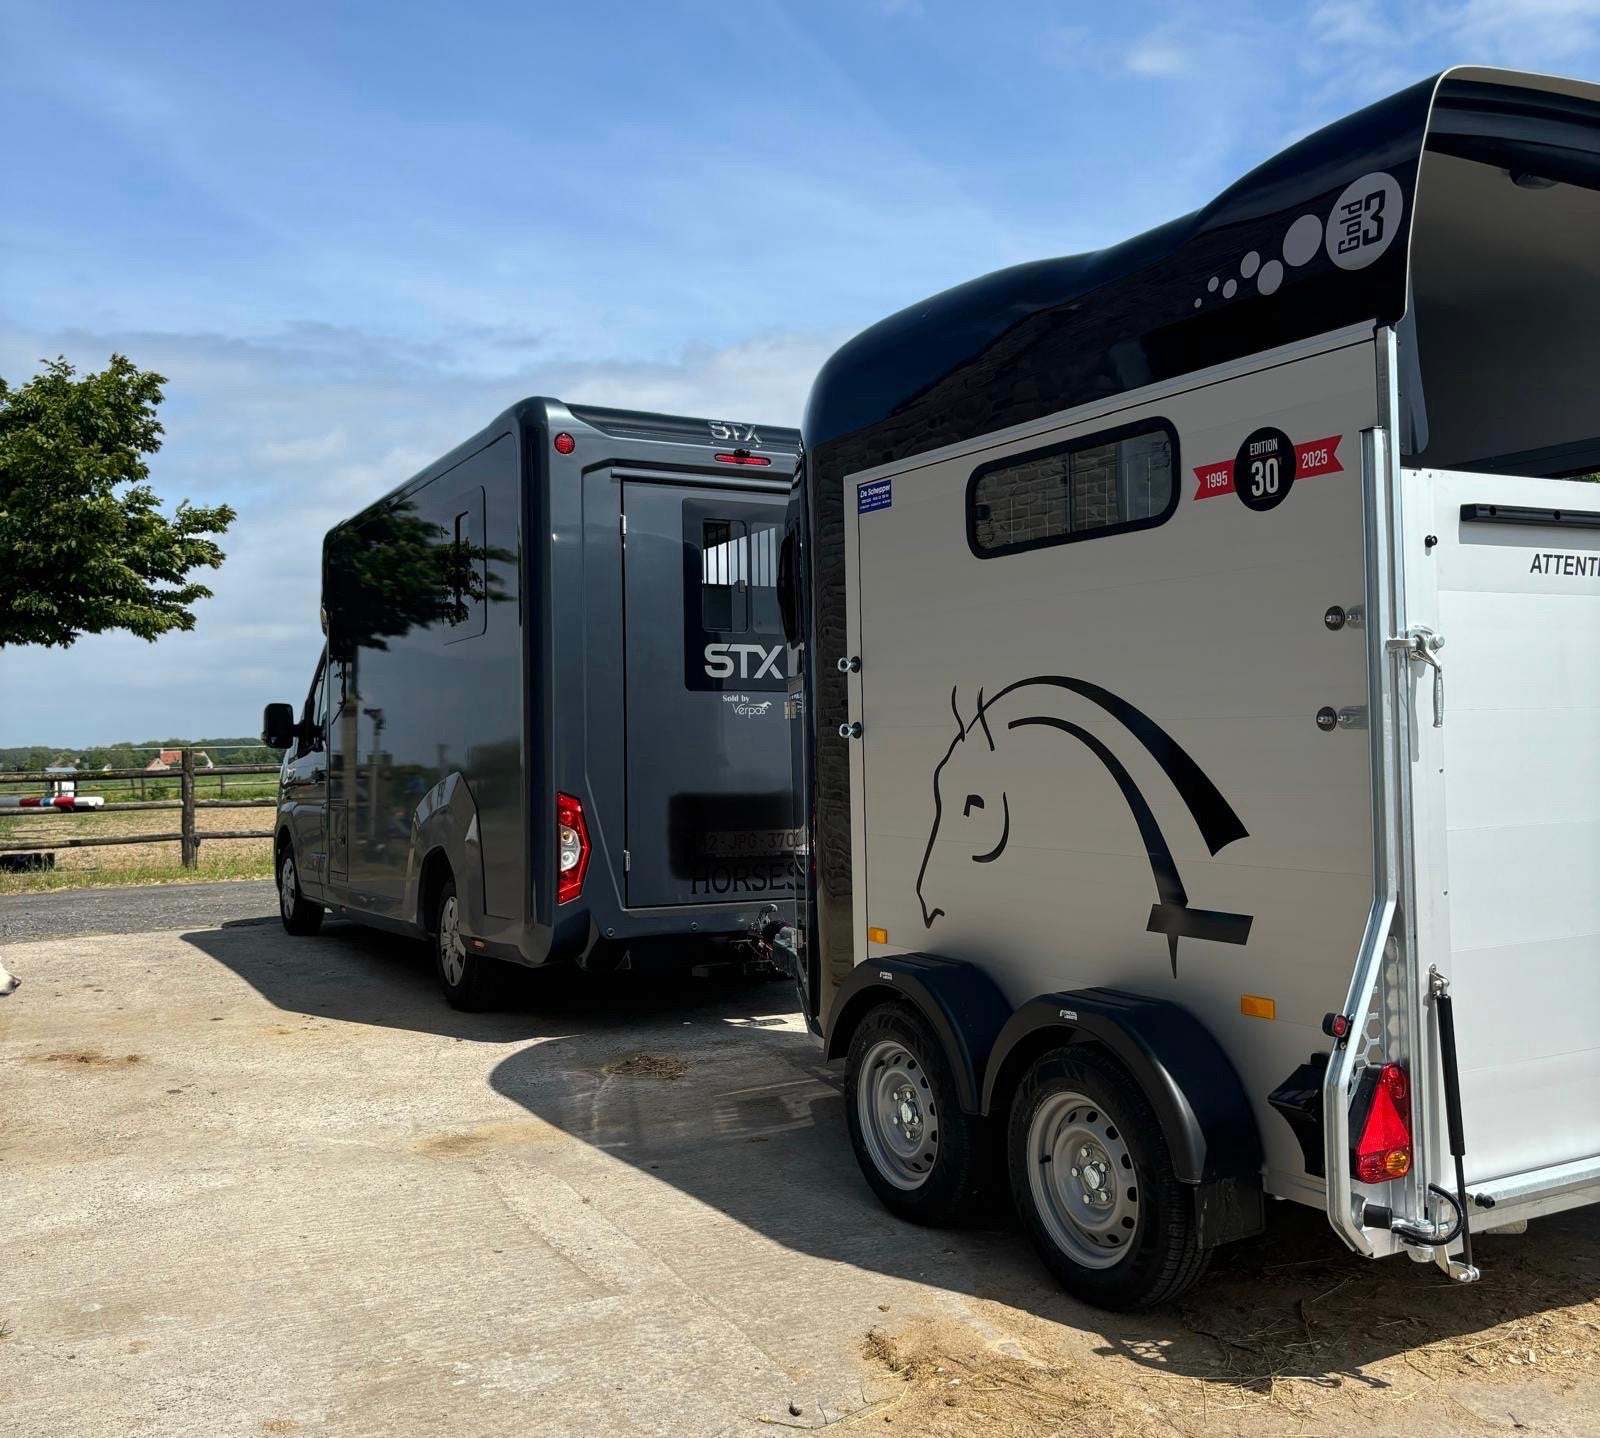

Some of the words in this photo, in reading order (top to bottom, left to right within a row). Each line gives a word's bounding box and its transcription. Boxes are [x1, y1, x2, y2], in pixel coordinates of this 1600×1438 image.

[1362, 189, 1386, 246] 3
[707, 421, 763, 443] STX
[1249, 437, 1278, 456] EDITION
[1301, 448, 1328, 469] 2025
[1206, 470, 1228, 489] 1995
[1251, 457, 1279, 497] 30
[704, 643, 784, 680] STX
[722, 694, 739, 702] Sold
[741, 694, 750, 704] by
[731, 703, 766, 719] Verpas
[691, 861, 805, 895] HORSES
